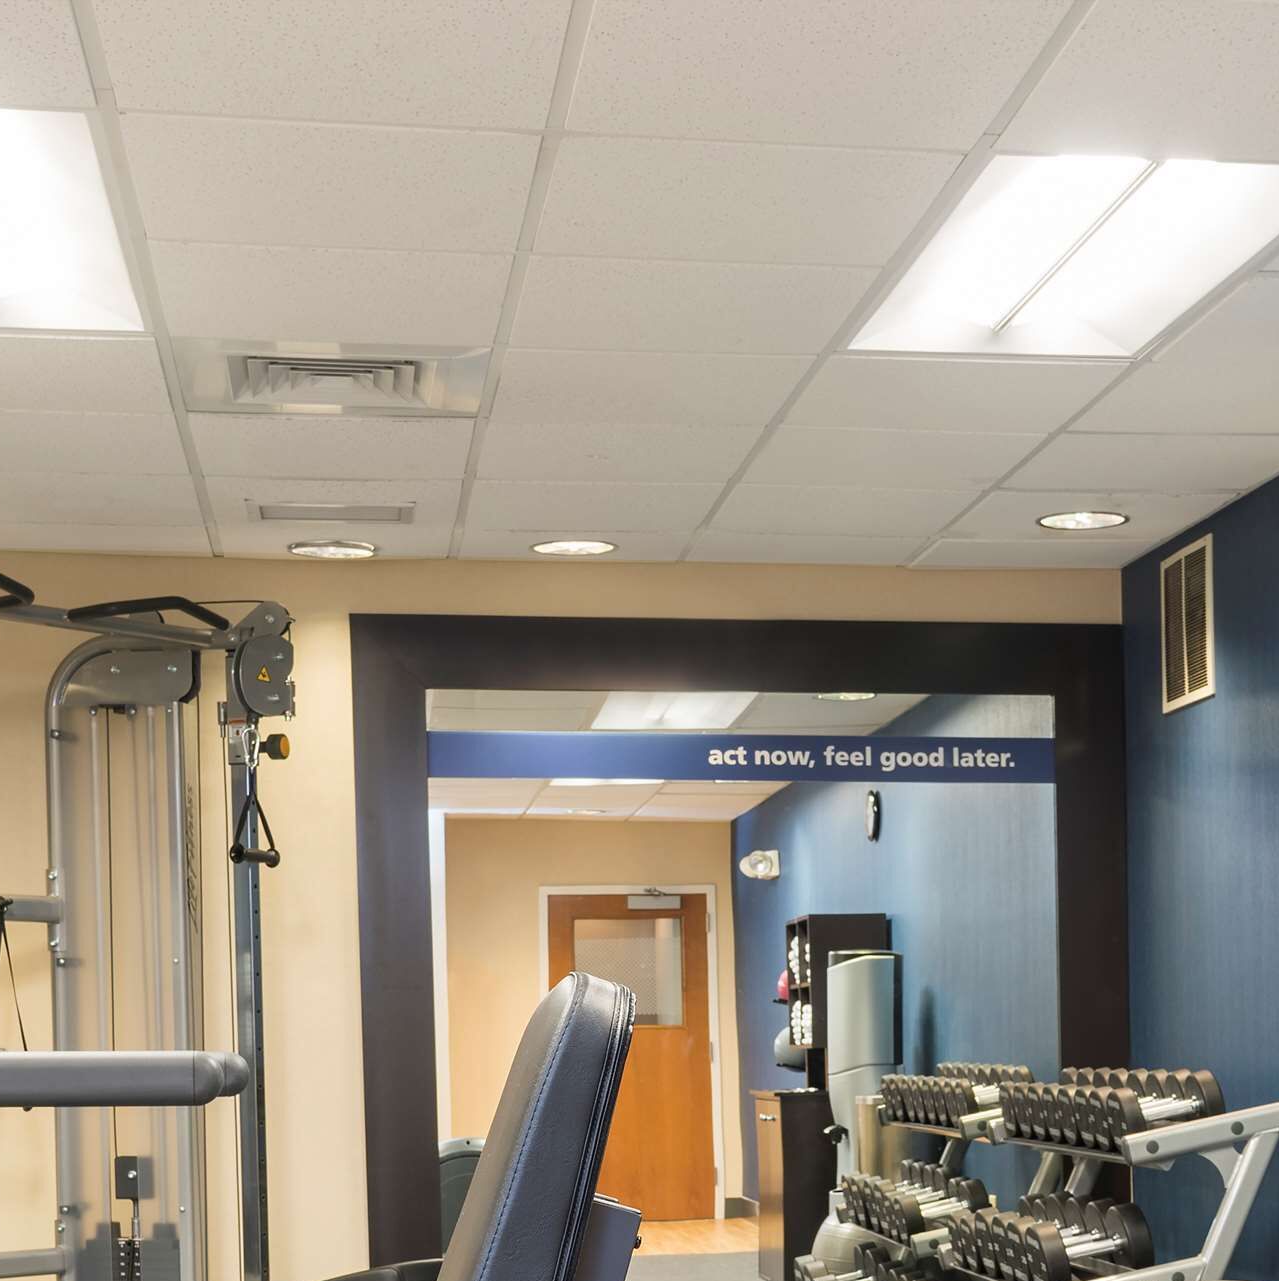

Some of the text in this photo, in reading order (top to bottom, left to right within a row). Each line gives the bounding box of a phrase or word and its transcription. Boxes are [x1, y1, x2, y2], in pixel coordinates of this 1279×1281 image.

[708, 745, 1016, 772] act now, feel good later.
